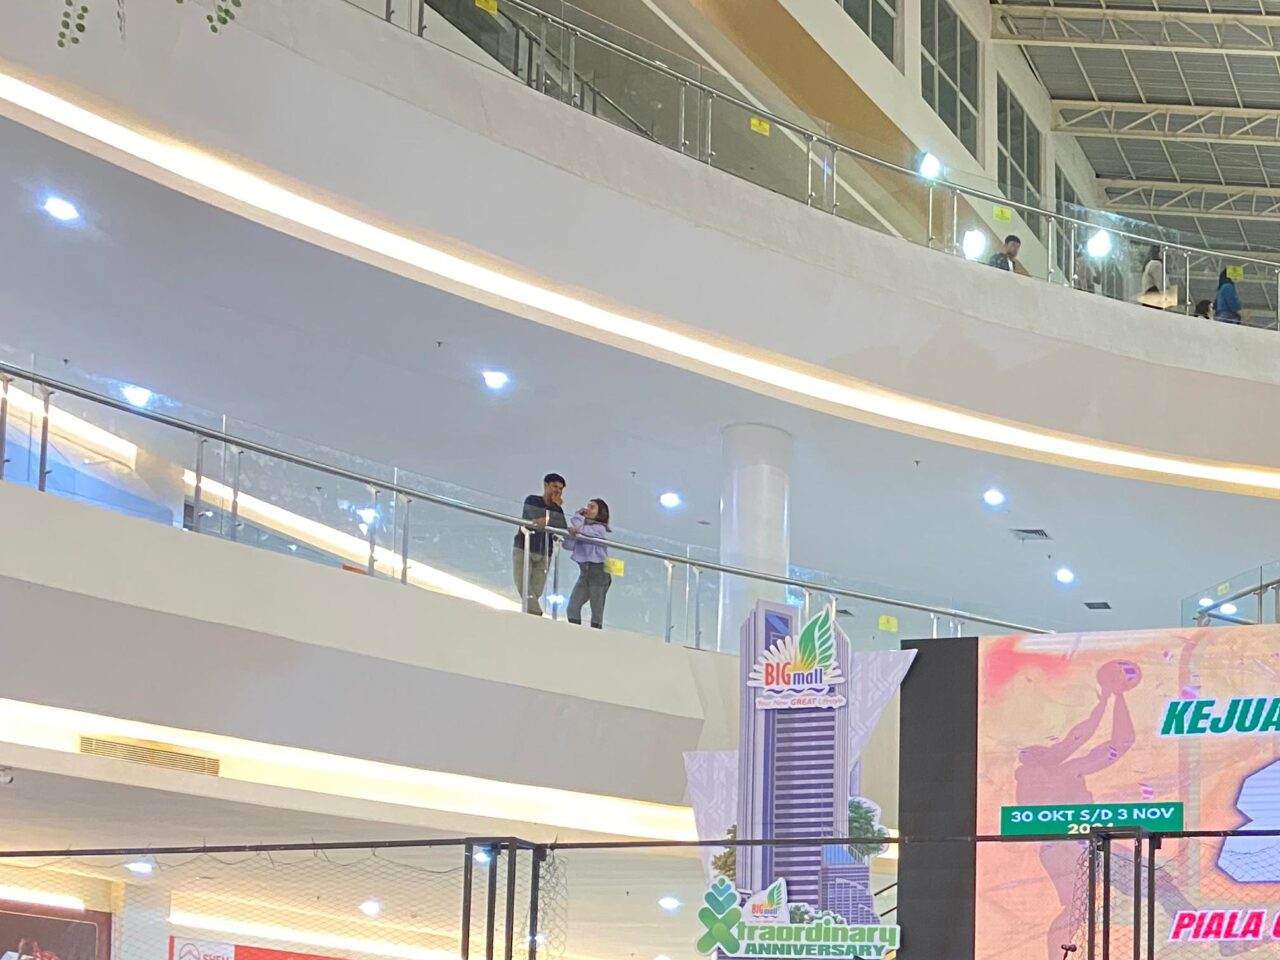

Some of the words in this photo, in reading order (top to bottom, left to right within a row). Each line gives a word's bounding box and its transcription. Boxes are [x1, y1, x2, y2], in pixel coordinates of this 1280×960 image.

[790, 697, 817, 707] GREAT
[1011, 810, 1034, 823] 30
[1037, 809, 1075, 822] OKT
[1079, 808, 1114, 823] S/D
[1117, 808, 1129, 820] 3
[1132, 806, 1175, 820] NOV
[1170, 910, 1265, 940] PIALA
[744, 943, 888, 957] ANNIVERSARY
